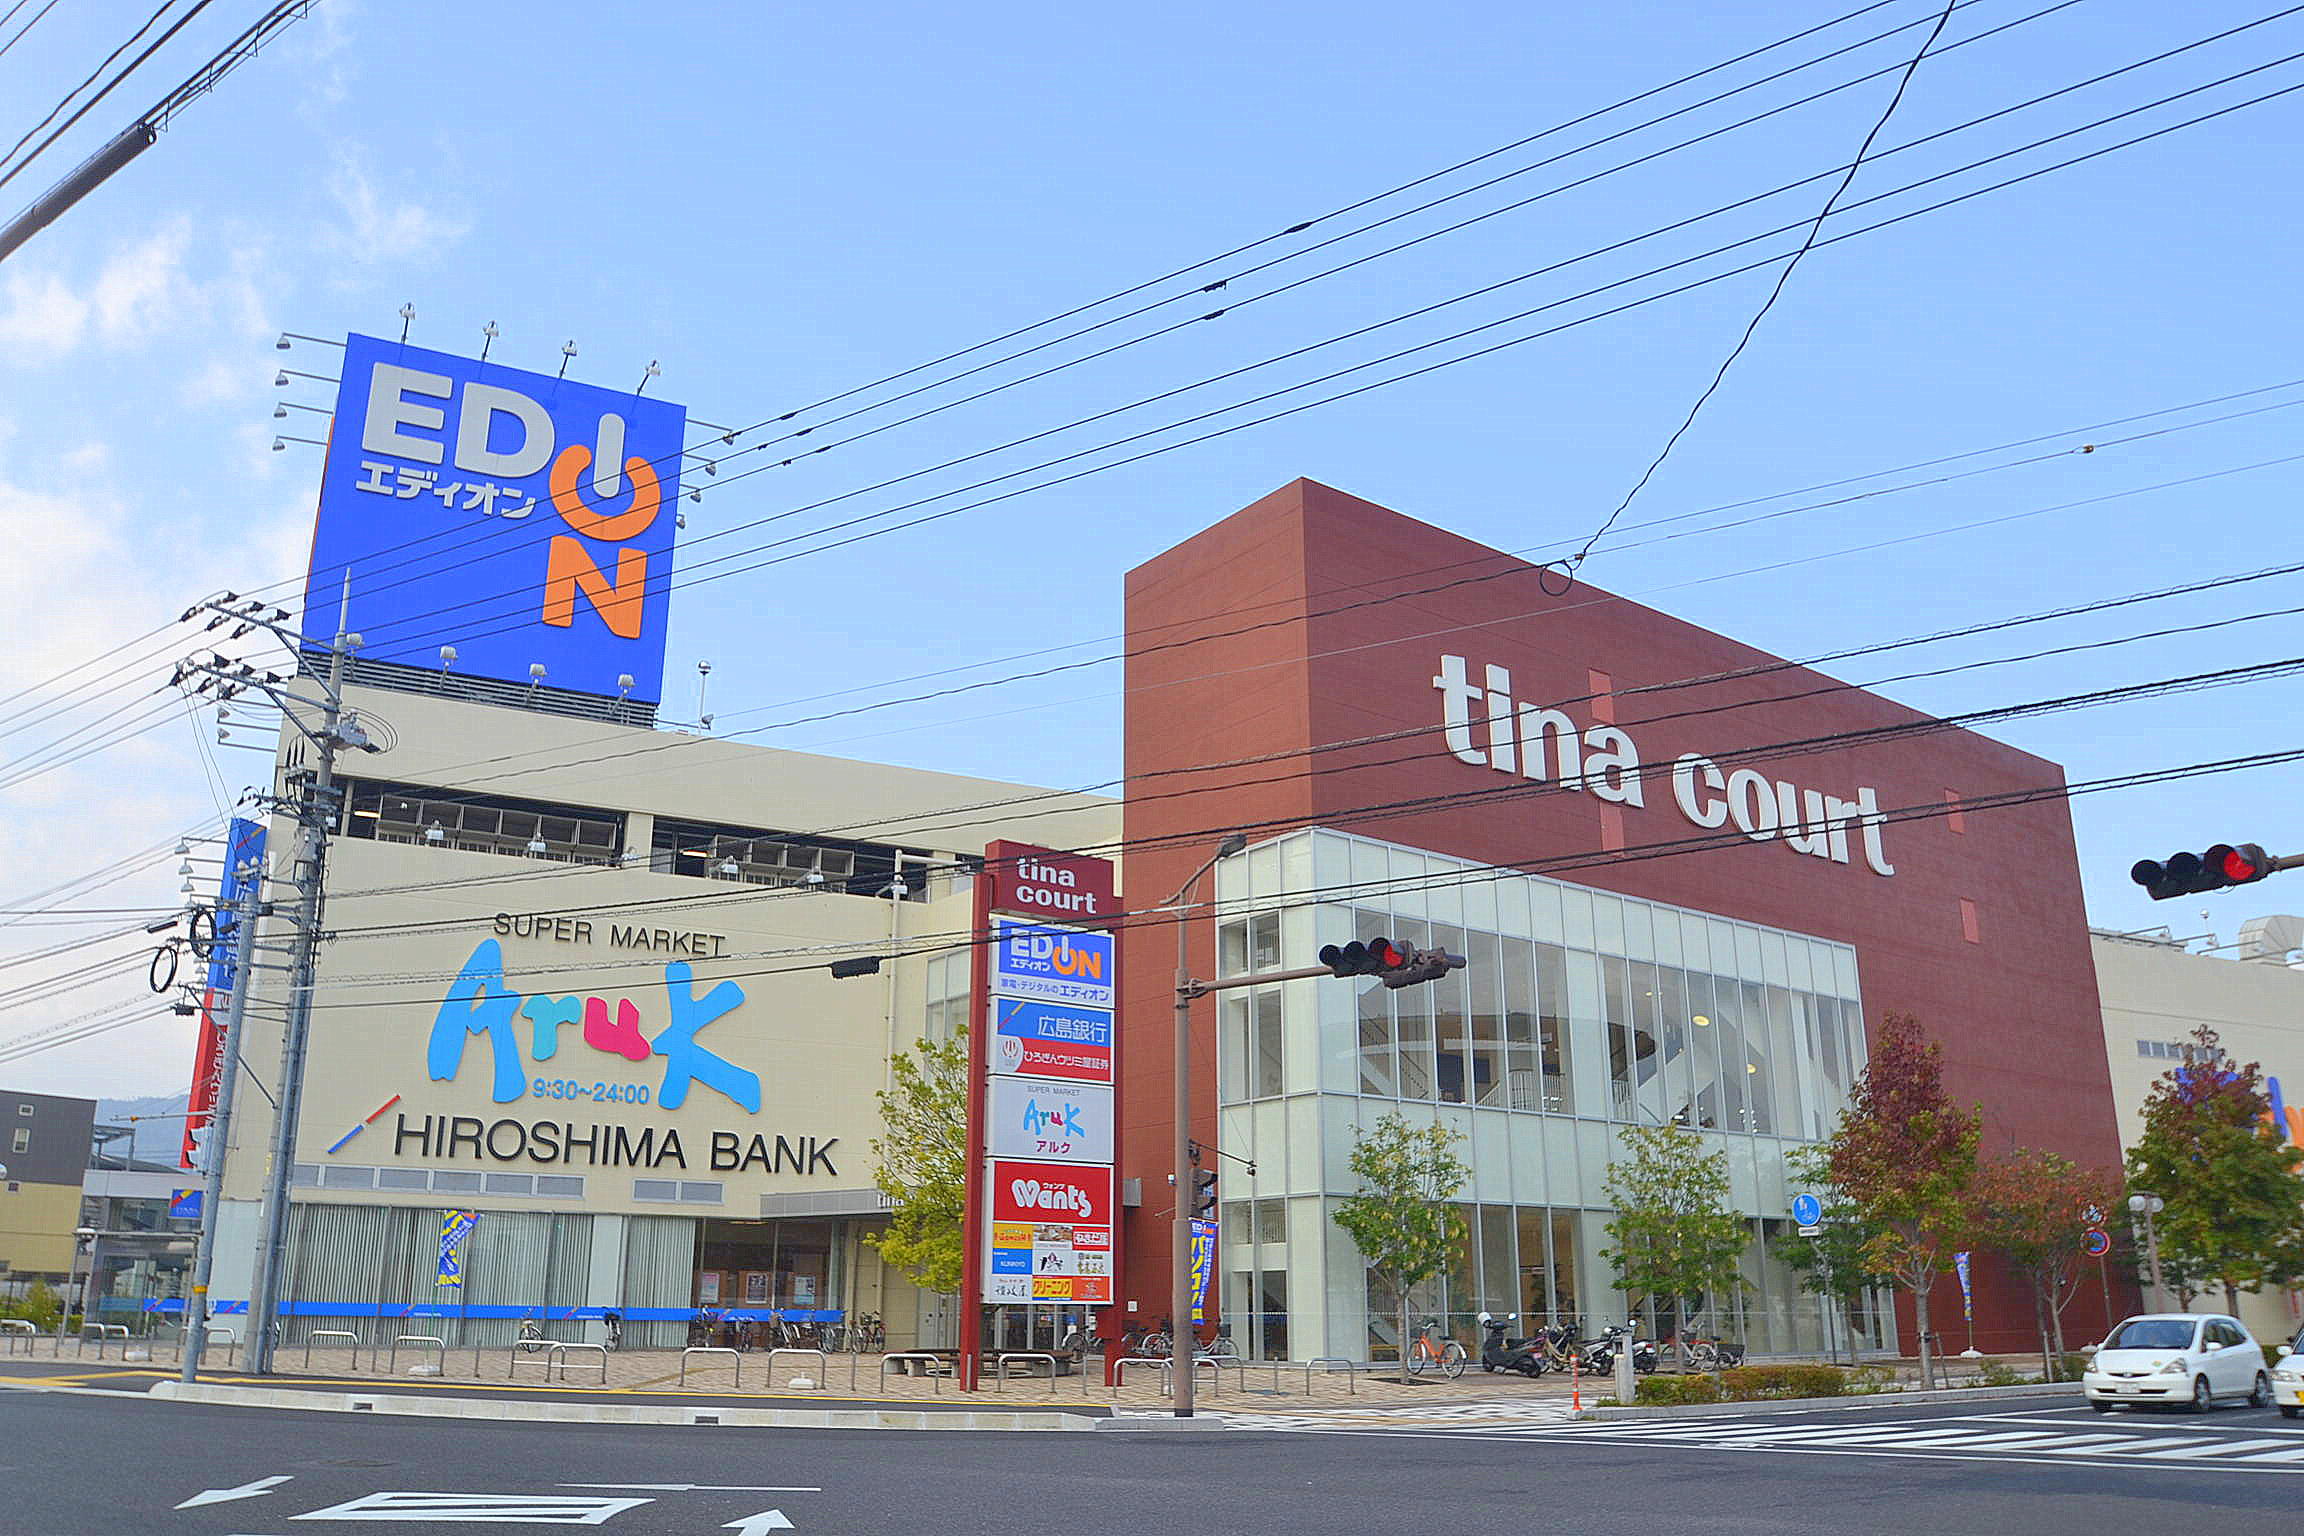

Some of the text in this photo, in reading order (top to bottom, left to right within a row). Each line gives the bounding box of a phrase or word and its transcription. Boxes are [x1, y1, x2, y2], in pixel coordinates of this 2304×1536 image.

[356, 460, 536, 519] エディオン
[1433, 654, 1895, 877] tina court
[1016, 855, 1075, 887] tina
[1016, 885, 1097, 914] court
[493, 913, 725, 957] SUPER MARKET
[1010, 958, 1050, 972] エディオン
[1059, 985, 1109, 1001] エディオン
[1038, 1015, 1107, 1042] 広島銀行
[1027, 1085, 1080, 1097] SUPER MARKET
[395, 1113, 840, 1176] HIROSHIMA BANK
[1036, 1140, 1071, 1154] アルク
[1011, 1179, 1092, 1218] Wants
